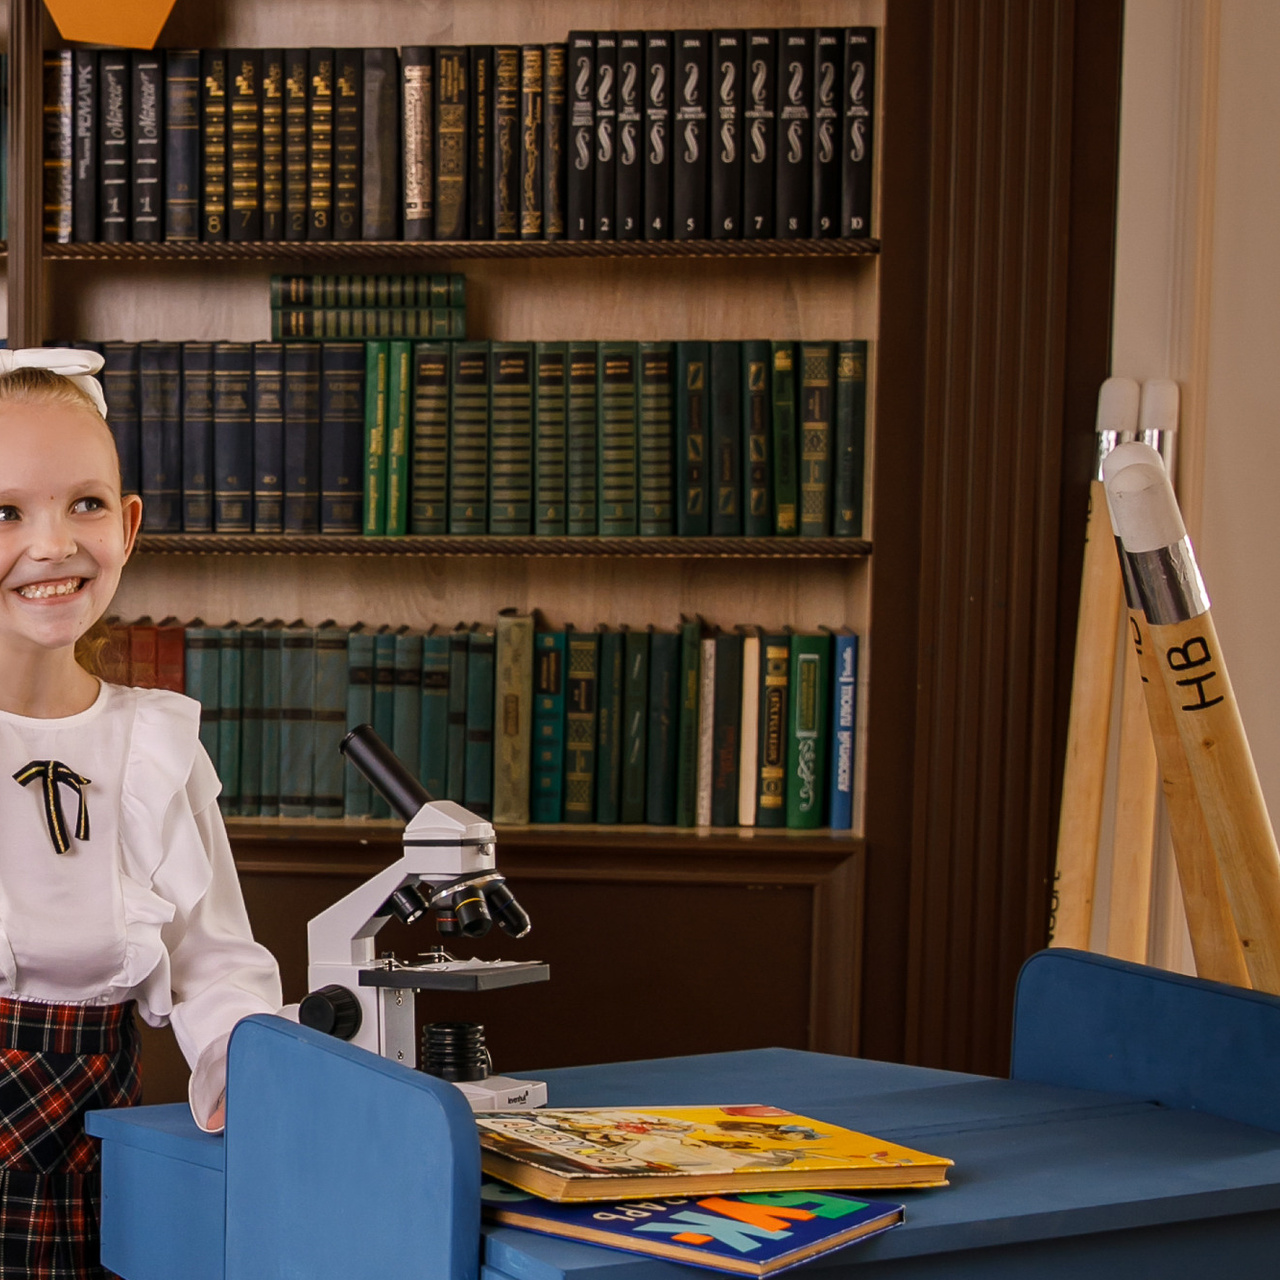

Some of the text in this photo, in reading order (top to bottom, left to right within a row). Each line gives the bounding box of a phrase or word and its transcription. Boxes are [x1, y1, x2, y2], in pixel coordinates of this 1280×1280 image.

[78, 64, 93, 138] РЕМАРК
[207, 216, 221, 233] 8
[240, 211, 251, 227] 7
[314, 211, 327, 228] 3
[578, 217, 585, 230] 1
[600, 218, 610, 231] 2
[624, 217, 633, 230] 3
[652, 217, 662, 230] 4
[686, 218, 695, 231] 5
[723, 217, 733, 230] 6
[754, 216, 764, 230] 7
[788, 217, 798, 230] 8
[820, 217, 830, 230] 9
[1165, 634, 1225, 712] HB
